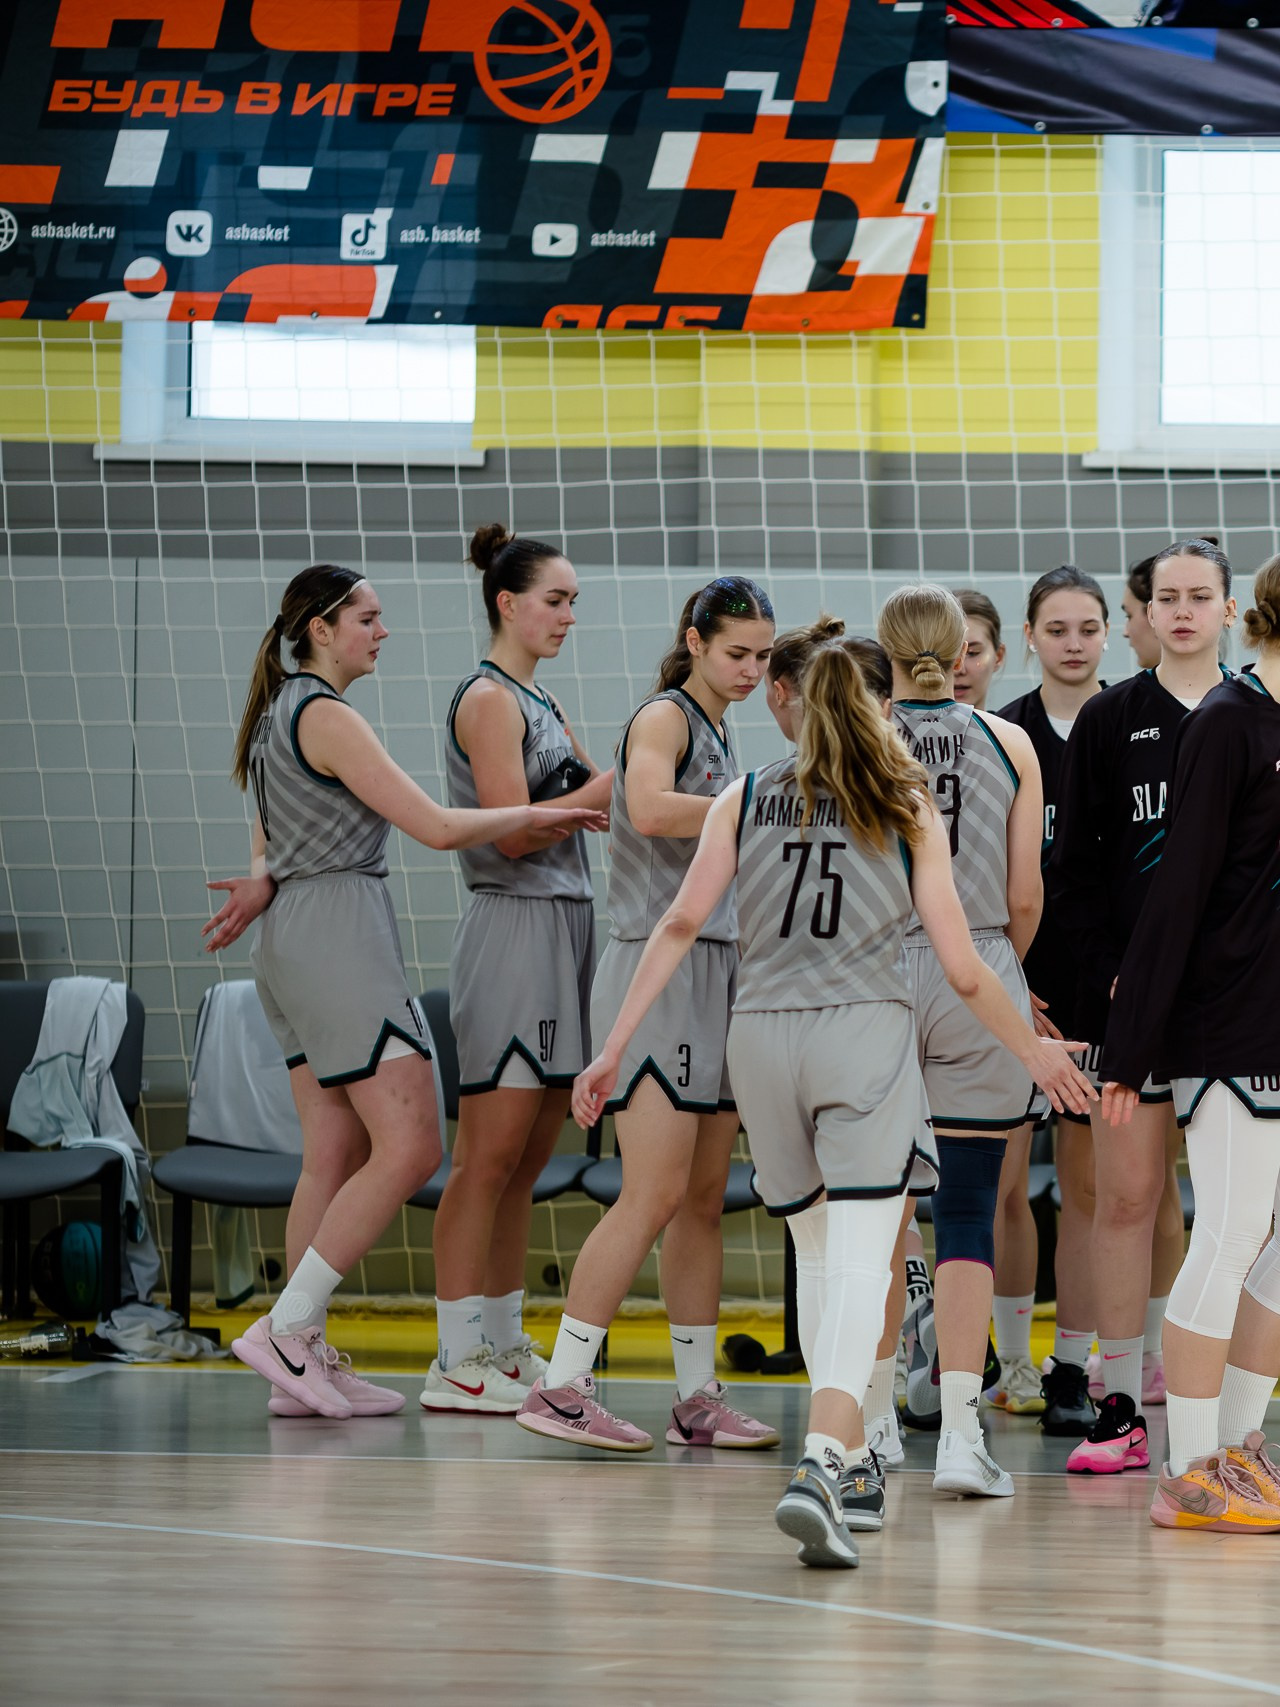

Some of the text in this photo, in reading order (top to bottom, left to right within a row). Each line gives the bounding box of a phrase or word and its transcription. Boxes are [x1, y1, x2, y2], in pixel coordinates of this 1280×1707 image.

[47, 79, 457, 118] БУДЬ В ИГРЕ
[31, 222, 116, 240] asbasket.ru
[225, 223, 290, 241] asbasket
[590, 230, 656, 247] asbasket
[779, 841, 847, 939] 75
[538, 1019, 557, 1063] 97
[678, 1043, 691, 1087] 3
